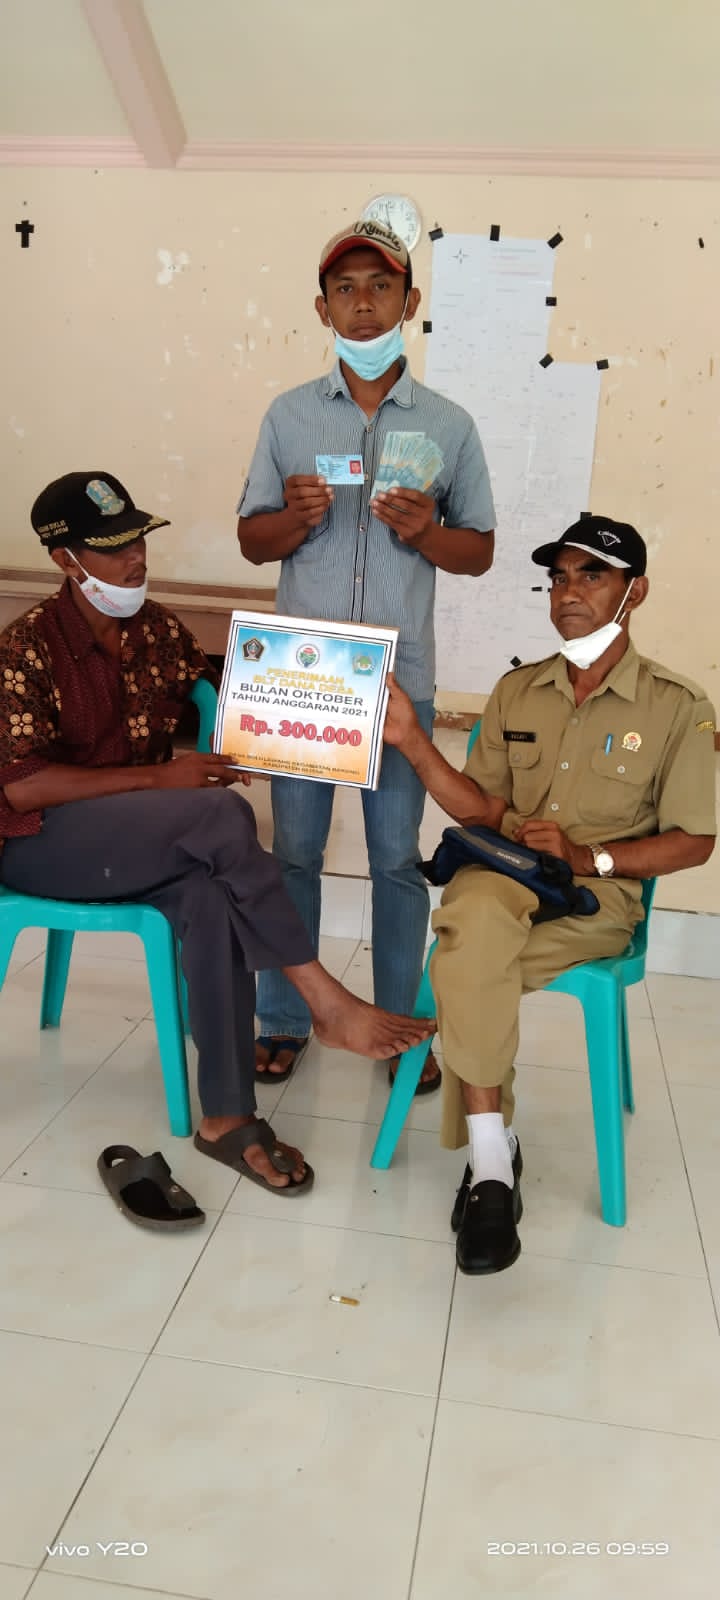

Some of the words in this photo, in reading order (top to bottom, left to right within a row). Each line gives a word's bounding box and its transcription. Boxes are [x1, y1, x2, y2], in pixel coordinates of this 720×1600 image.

[253, 674, 276, 685] BLT
[279, 678, 315, 690] DANA
[319, 683, 355, 695] DESA
[267, 667, 344, 684] PENERIMAAN
[232, 692, 270, 705] TAHUN
[272, 697, 339, 713] ANGGARAN
[341, 707, 368, 718] 2021
[240, 683, 288, 697] BULAN
[292, 689, 364, 706] OKTOBER
[240, 714, 273, 736] Rp.
[278, 719, 362, 747] 300.000
